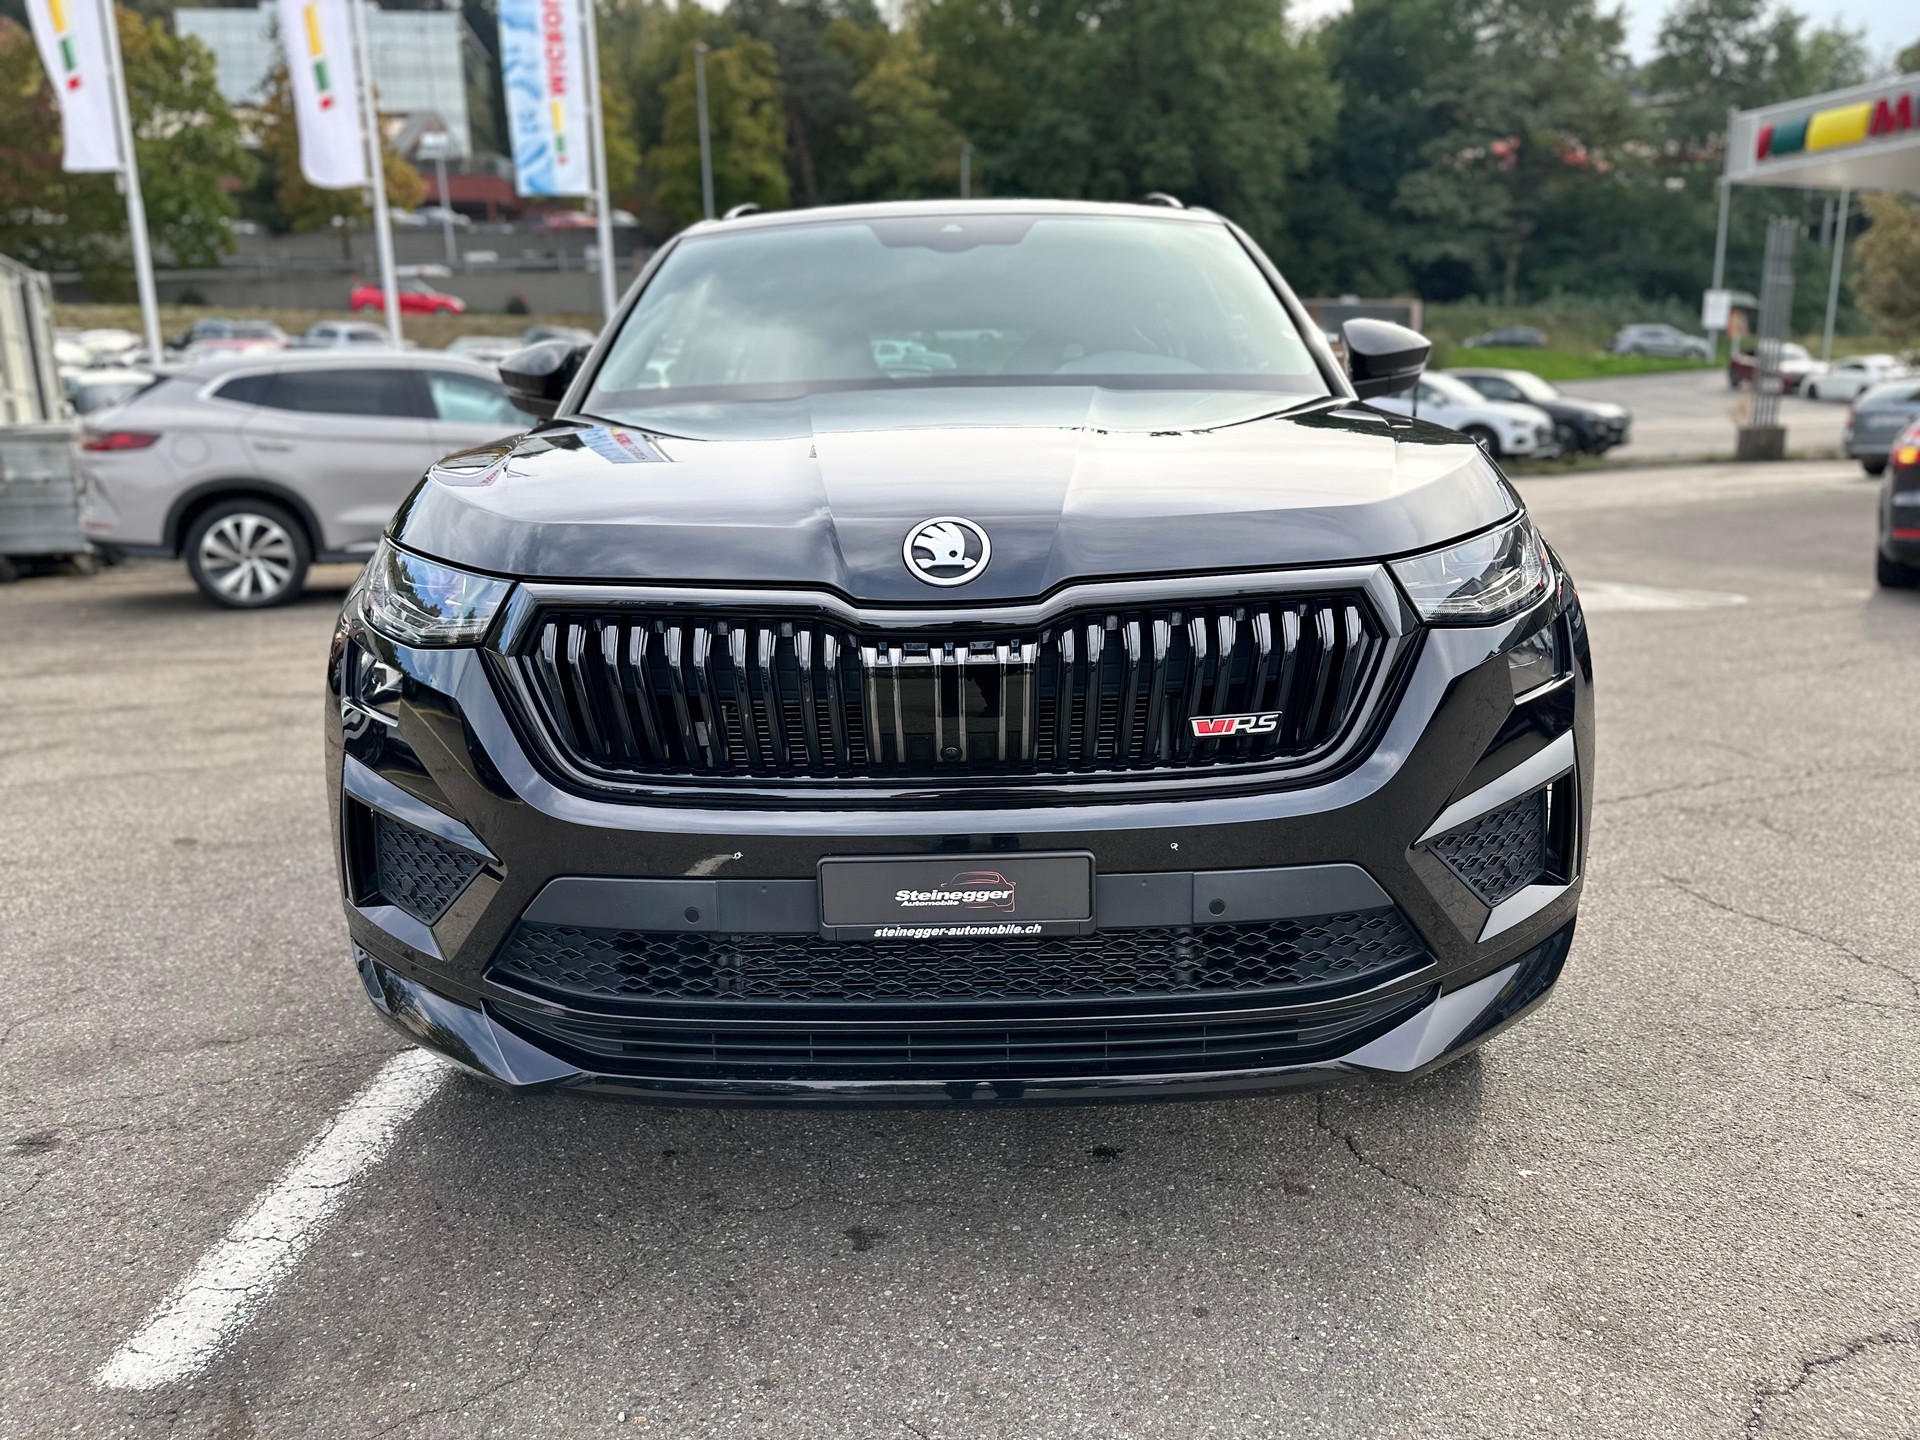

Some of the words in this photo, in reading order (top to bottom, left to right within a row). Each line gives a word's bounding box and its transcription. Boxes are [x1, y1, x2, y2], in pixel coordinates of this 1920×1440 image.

[1869, 94, 1920, 137] M
[894, 889, 1013, 902] Steinegger
[873, 924, 1042, 938] steinegger-automobile.ch
